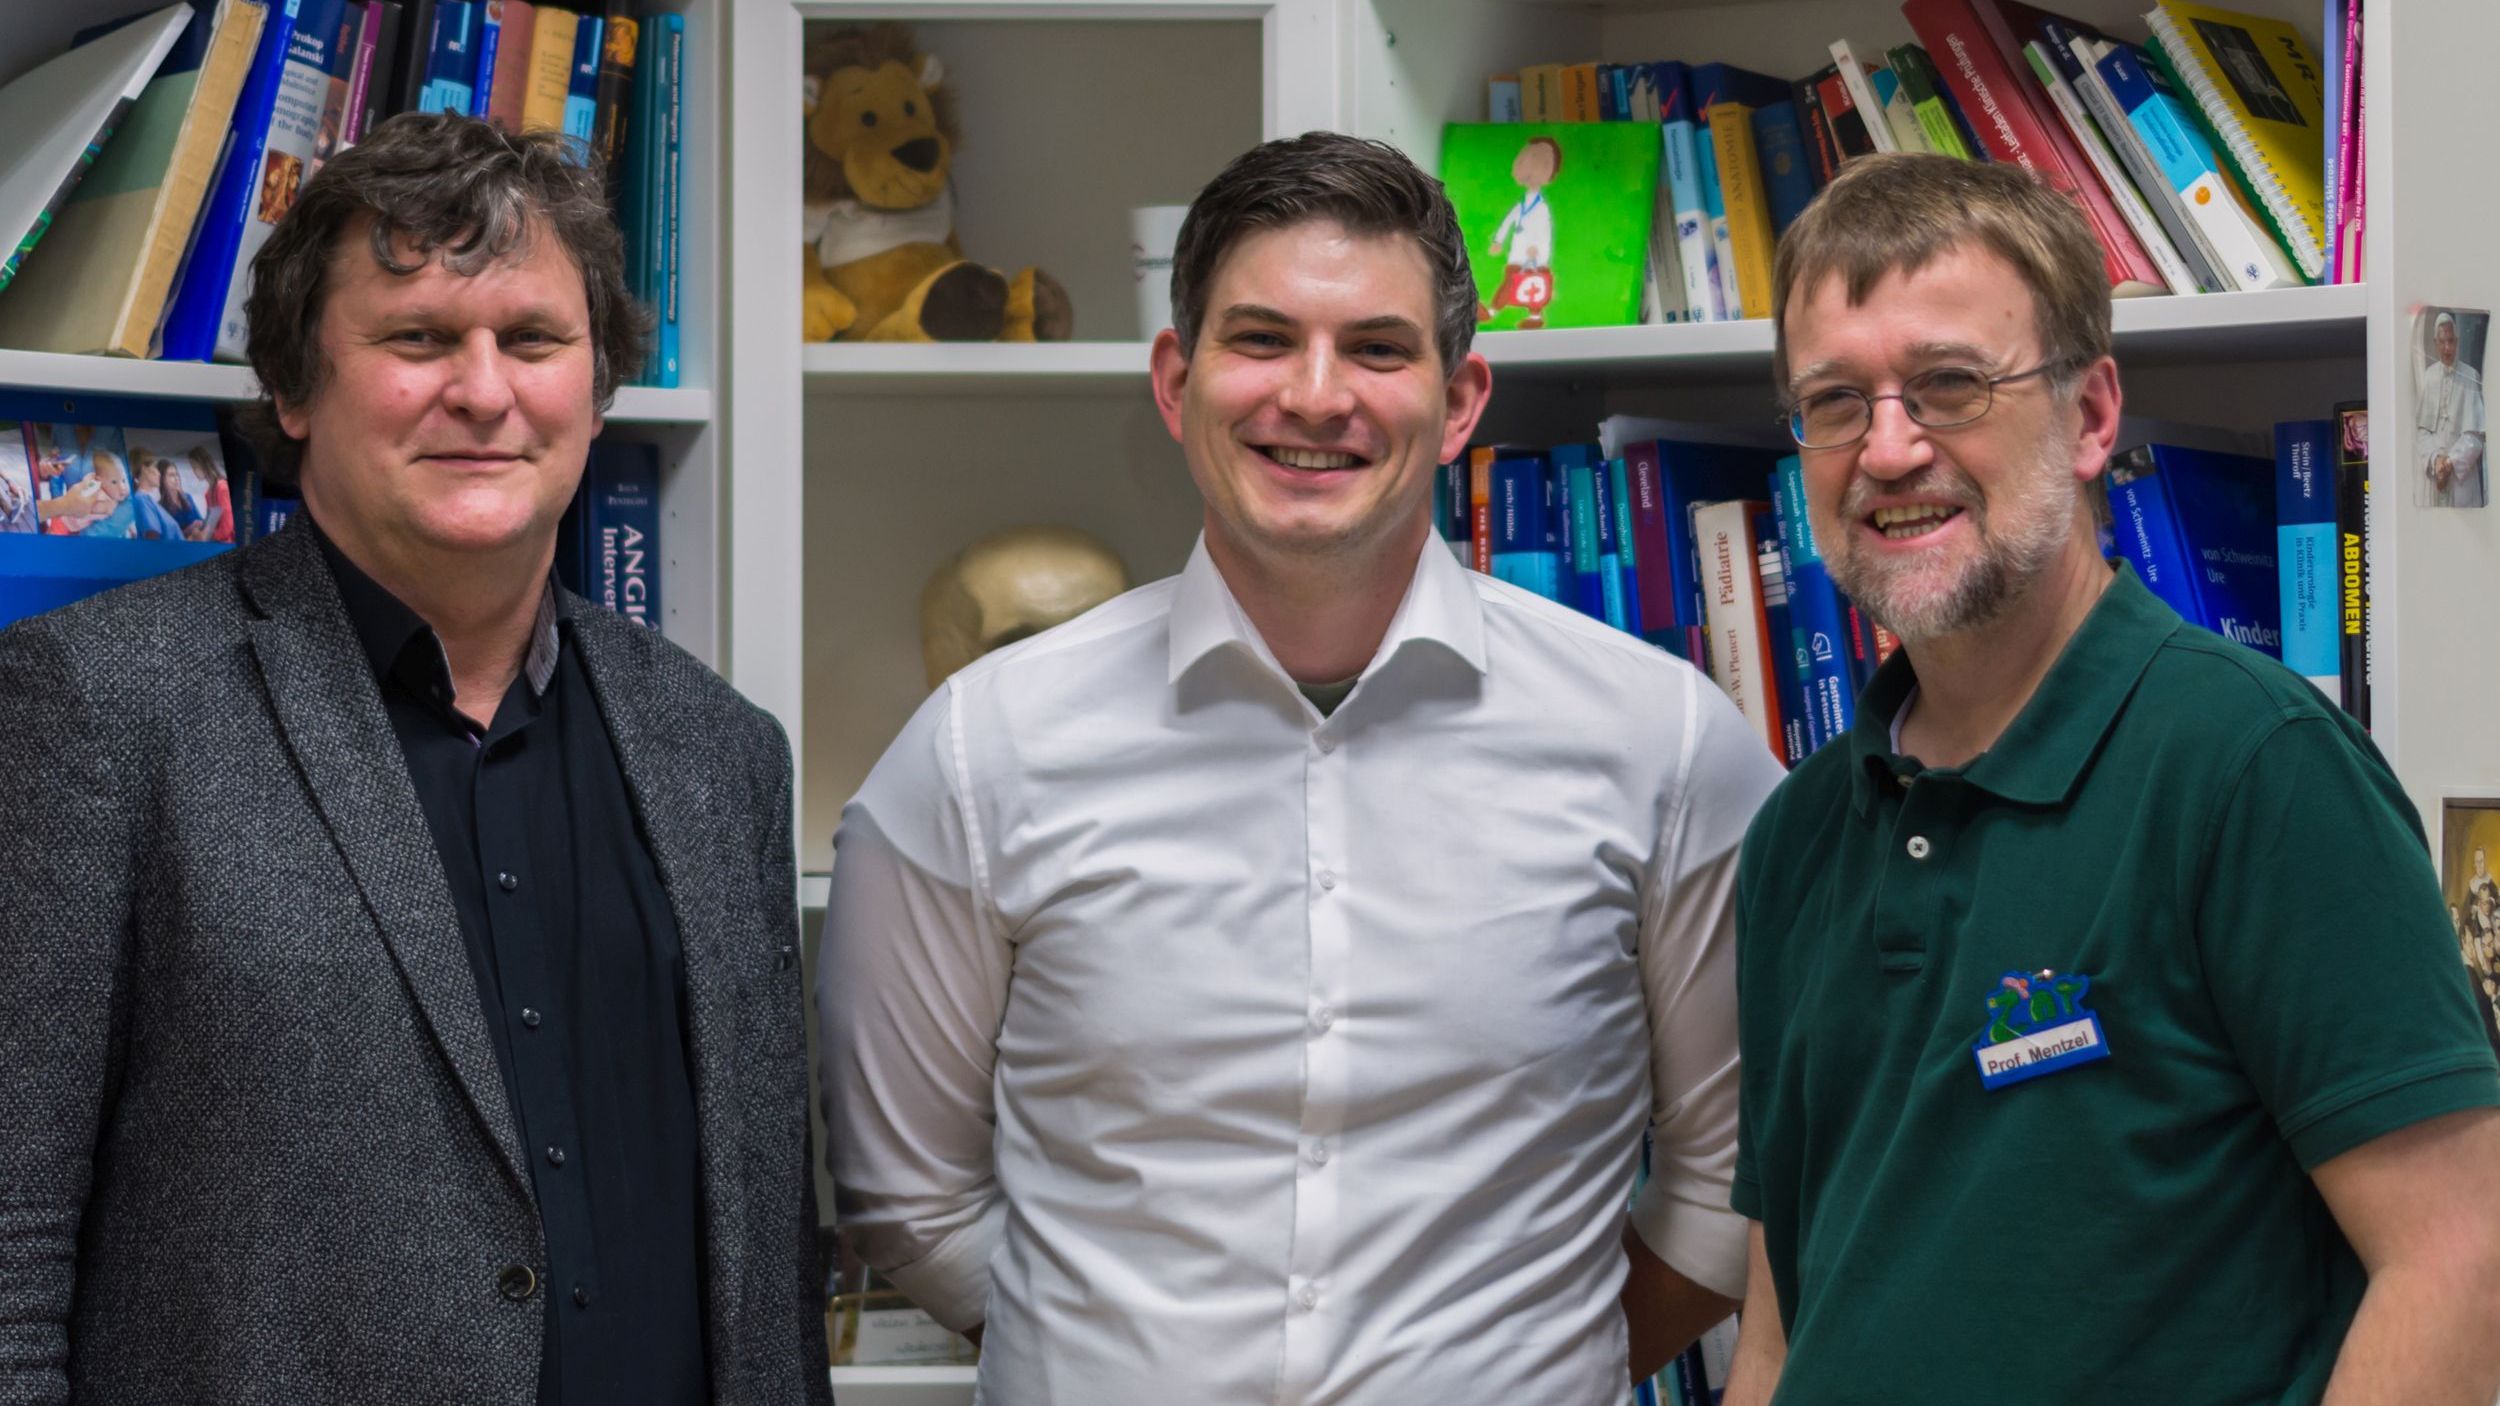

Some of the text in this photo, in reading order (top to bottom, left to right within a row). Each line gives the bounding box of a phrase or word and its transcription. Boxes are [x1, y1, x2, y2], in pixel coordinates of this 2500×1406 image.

[671, 34, 680, 82] Pettersson
[1939, 29, 1981, 79] Prüfungen
[671, 85, 679, 101] and
[1965, 73, 2000, 115] Klinische
[2342, 63, 2352, 121] Gastrointestinale
[1987, 109, 2022, 152] Leitfaden
[1722, 123, 1744, 202] ANATOMIE
[2326, 158, 2335, 249] Tuberöse Sklerose
[2336, 186, 2344, 225] Grundlagen
[667, 152, 678, 320] Measurements in Pediatric Radiology
[2291, 442, 2301, 479] Thüroff
[2301, 441, 2312, 498] Stein/Beetz
[1636, 460, 1653, 509] Cleveland
[2126, 489, 2158, 583] von Schweinitz Ure
[2295, 536, 2304, 546] in
[1719, 530, 1735, 606] Pädiatrie
[2201, 547, 2274, 569] von Schweinitz
[2207, 568, 2225, 584] Ure
[2302, 536, 2319, 609] Kinderurologie
[2296, 580, 2305, 599] und
[2344, 532, 2360, 635] ABDOMEN
[2220, 617, 2280, 647] Kinder
[2296, 601, 2306, 631] Praxis
[1726, 629, 1739, 672] Plenert
[1816, 677, 1826, 689] in
[1817, 690, 1833, 731] Fetuses
[1987, 1031, 2089, 1075] Prof. Mentzel
